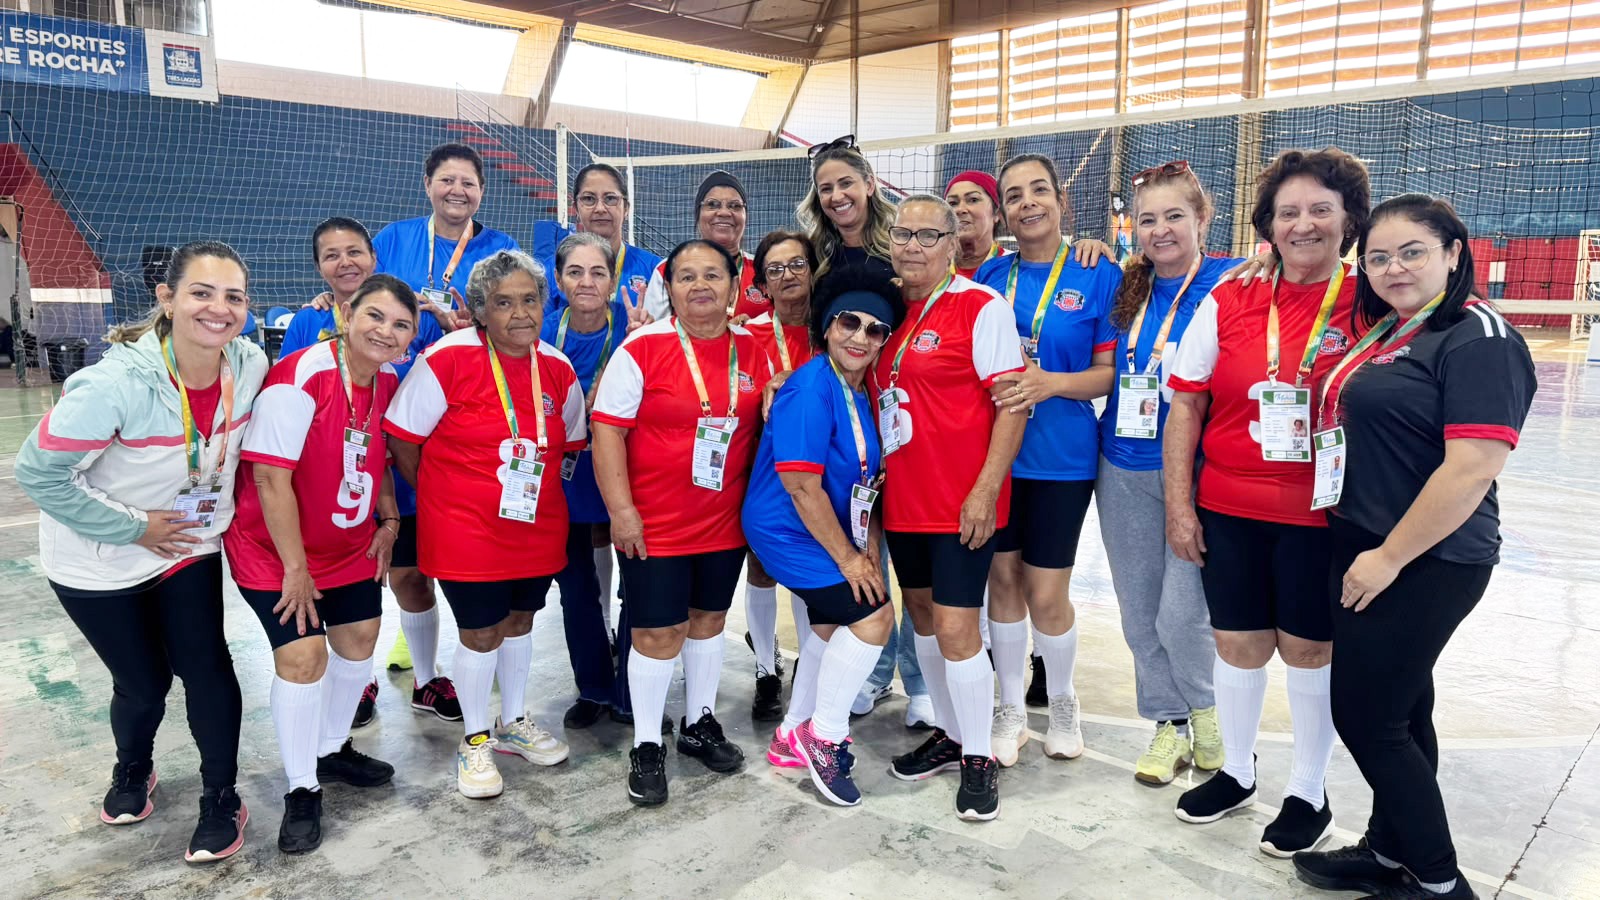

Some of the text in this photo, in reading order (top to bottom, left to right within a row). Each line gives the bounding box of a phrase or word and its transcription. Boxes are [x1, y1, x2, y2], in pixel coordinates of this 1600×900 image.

[9, 26, 126, 55] ESPORTES
[0, 46, 21, 65] E
[331, 471, 374, 529] 9
